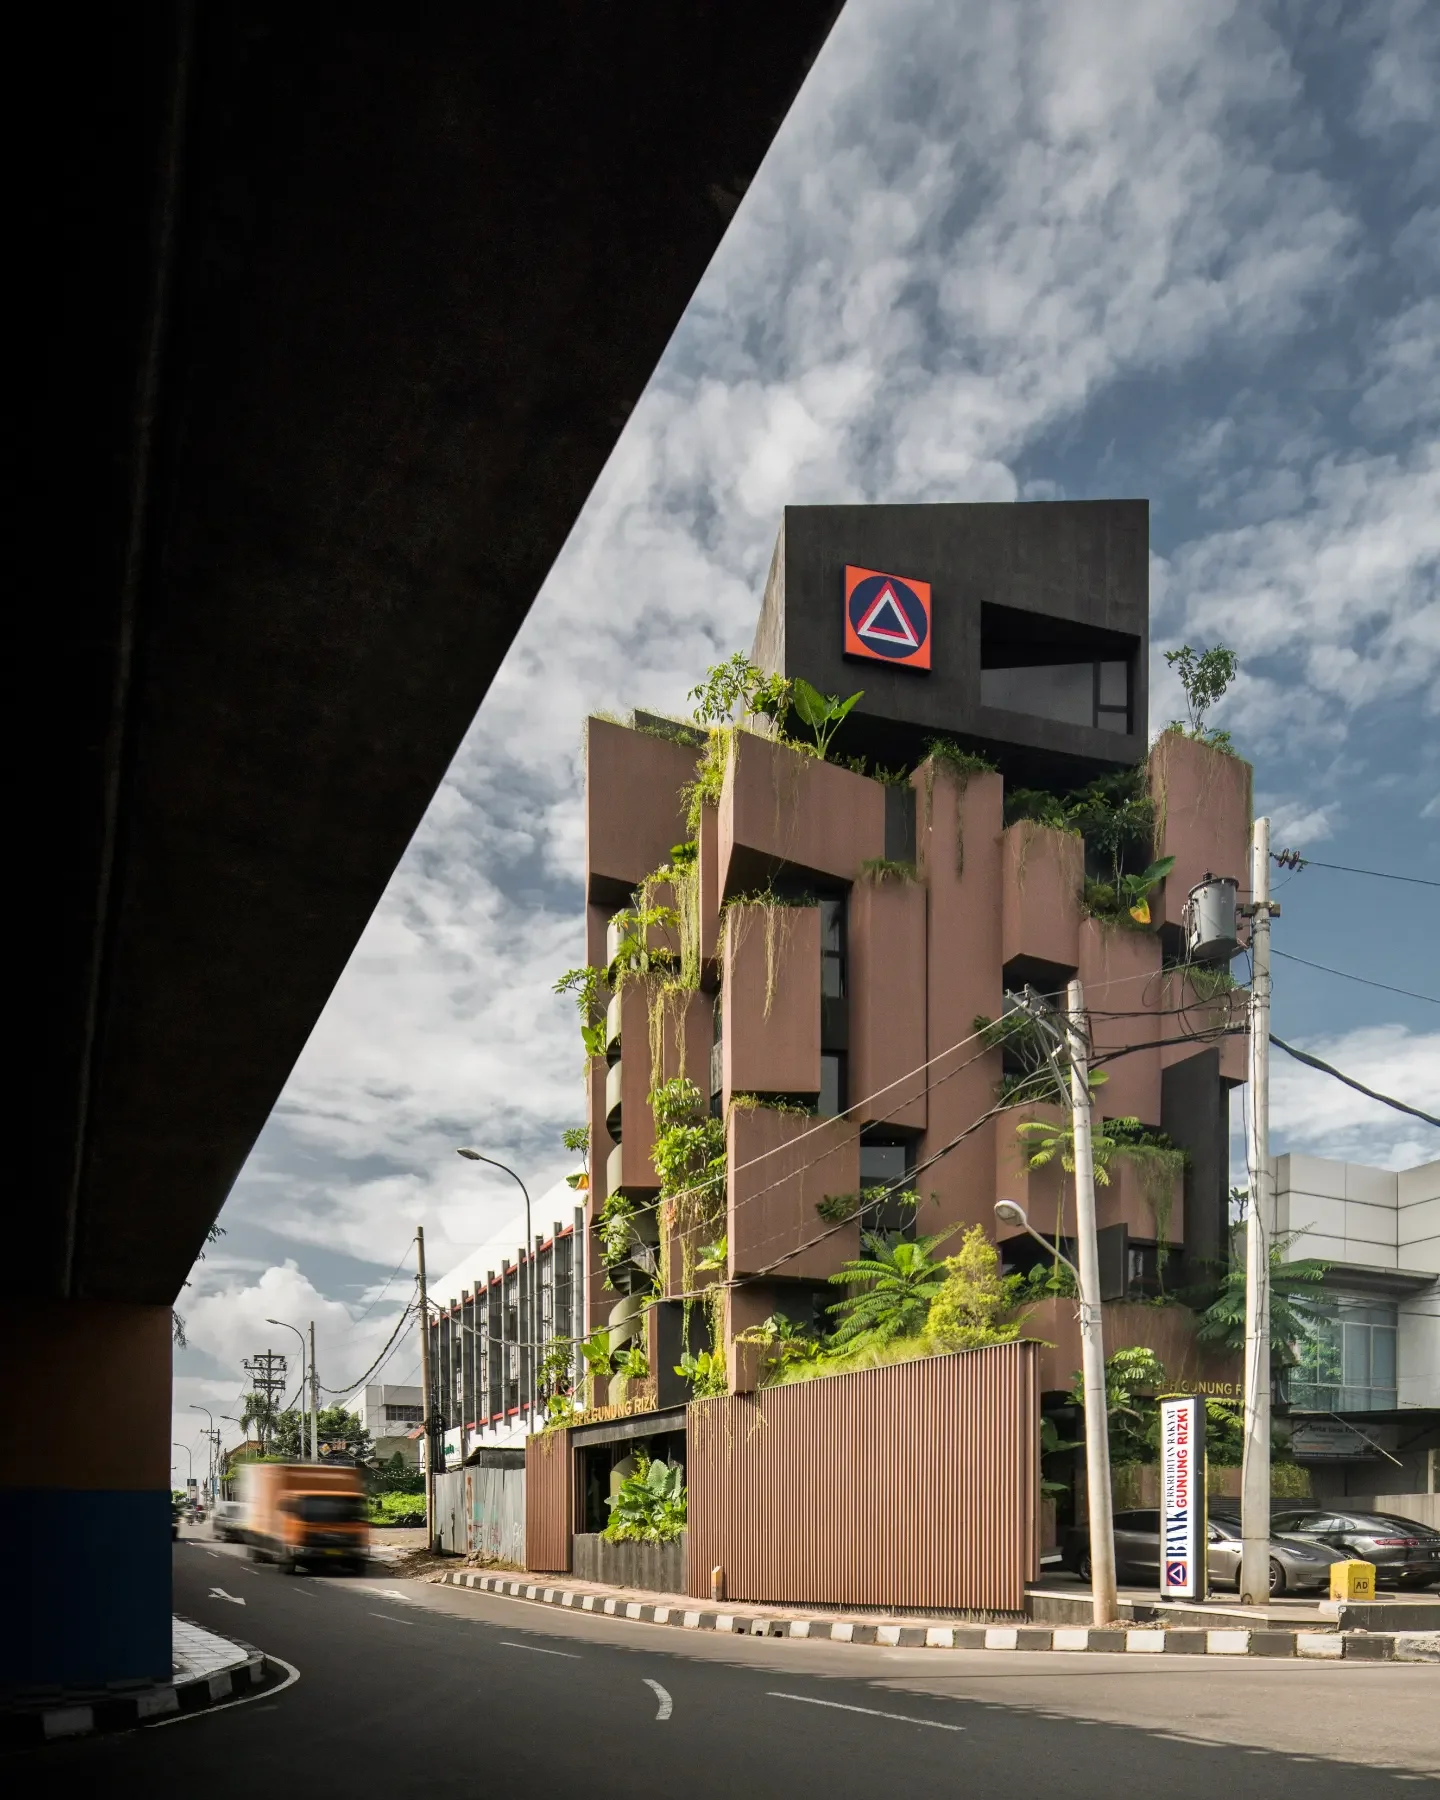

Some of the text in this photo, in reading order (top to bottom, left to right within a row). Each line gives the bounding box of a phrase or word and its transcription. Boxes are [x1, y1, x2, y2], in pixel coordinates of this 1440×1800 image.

[591, 1401, 633, 1422] GUNUNG
[1166, 1409, 1176, 1508] PERKREDITAN RAKYAT
[1176, 1408, 1188, 1508] GUNUNG RIZKI
[1166, 1510, 1188, 1558] BANK
[1356, 1582, 1368, 1590] AD
